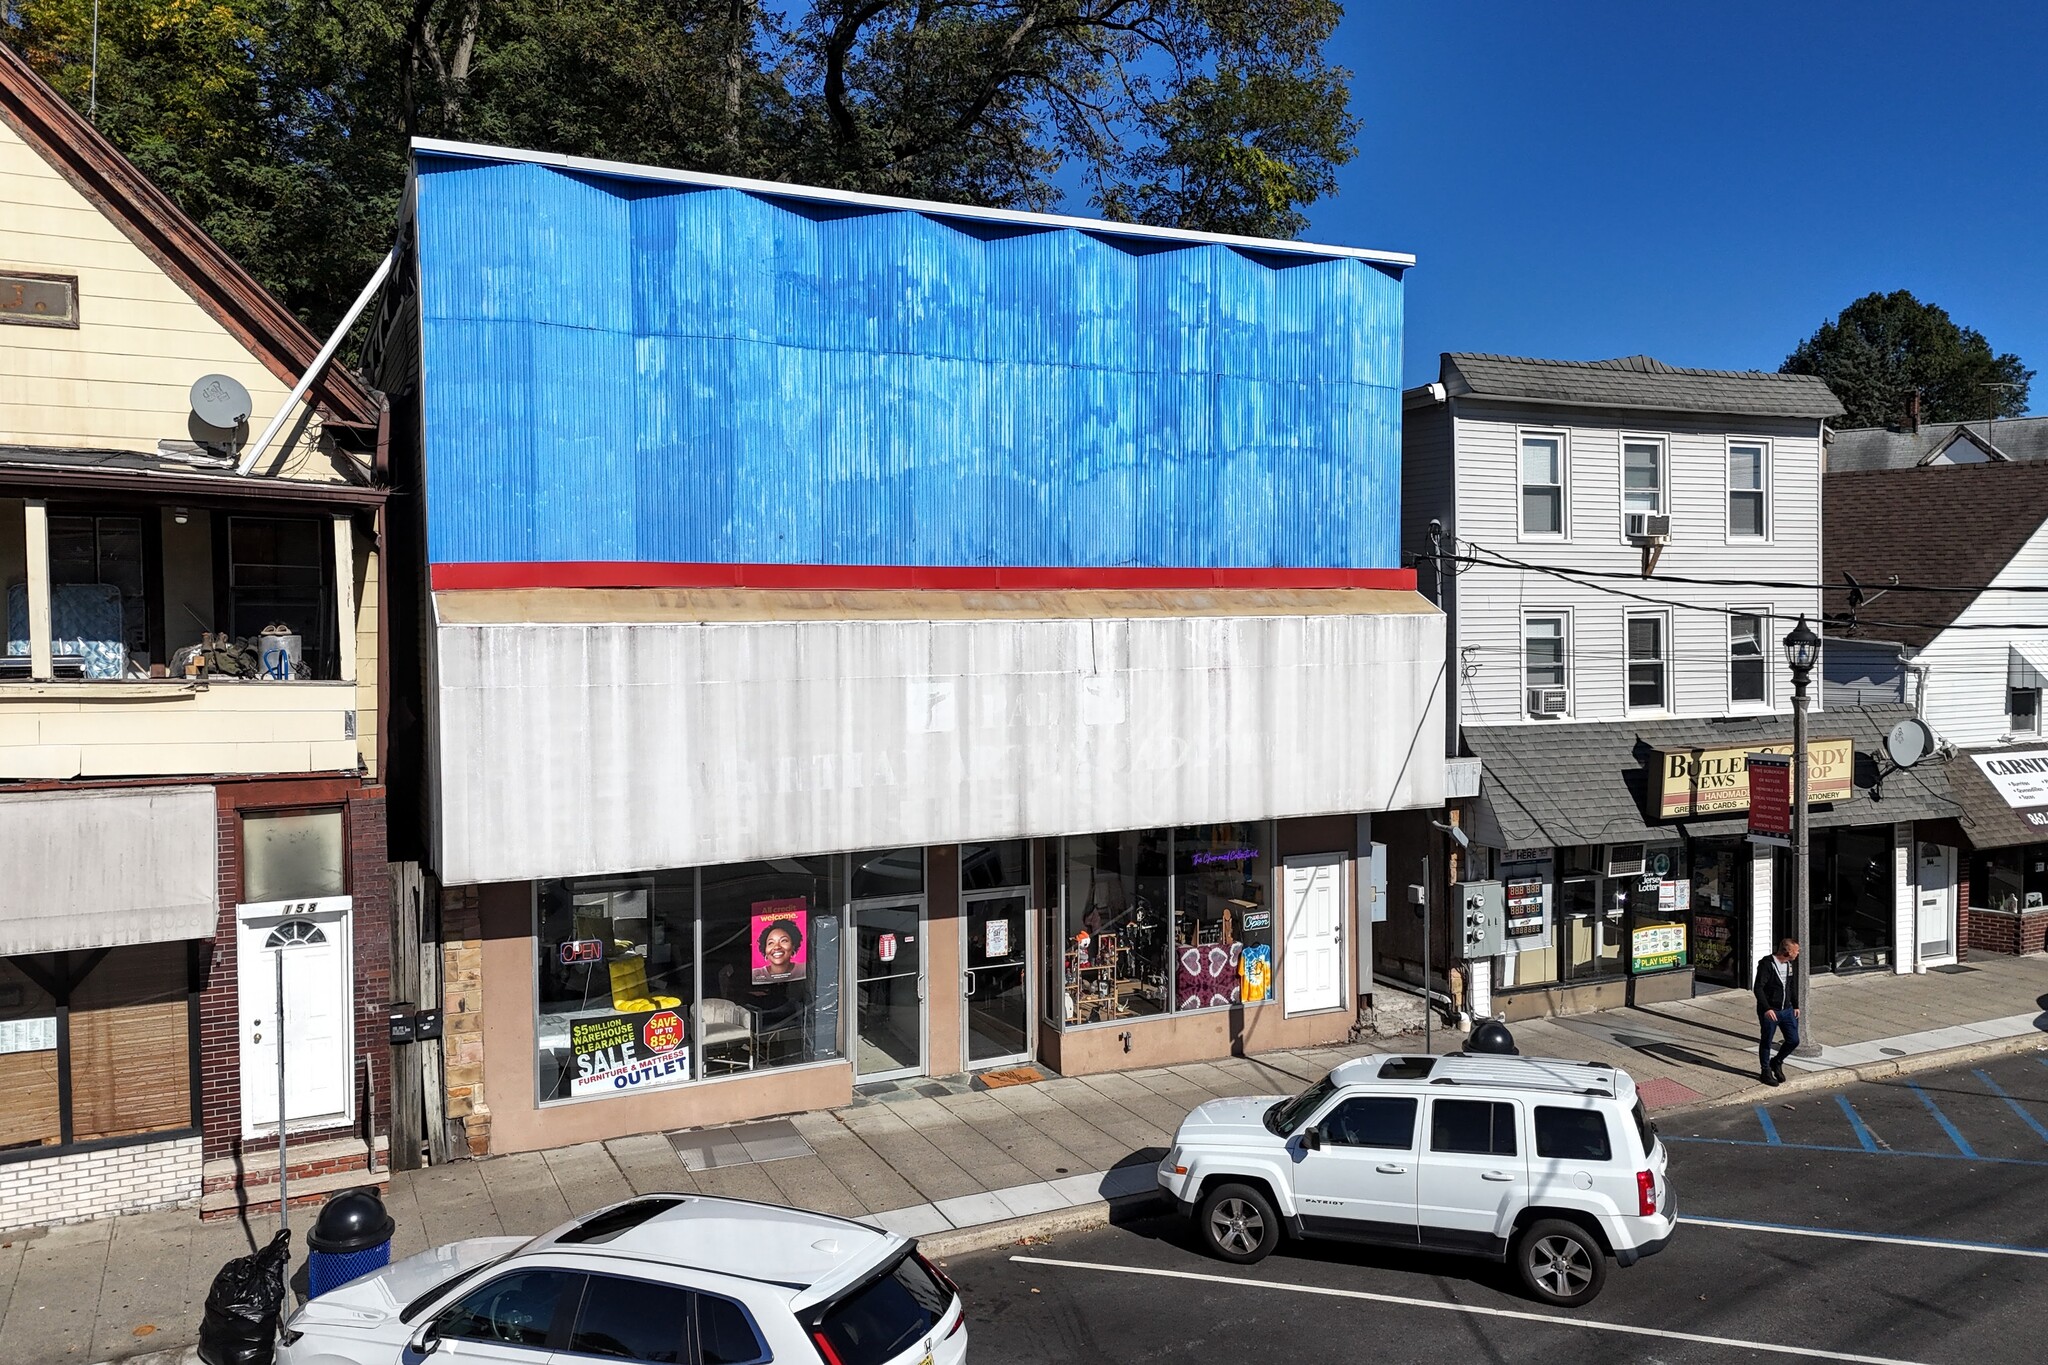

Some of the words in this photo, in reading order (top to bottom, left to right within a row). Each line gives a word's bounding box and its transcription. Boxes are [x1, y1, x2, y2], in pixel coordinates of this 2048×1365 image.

[1687, 773, 1735, 790] NEWS
[1674, 804, 1710, 813] GREETING
[1712, 801, 1737, 810] CARDS
[1806, 791, 1840, 801] ATIONERY
[1517, 851, 1537, 859] HERE
[1639, 884, 1660, 892] Lotter
[282, 902, 318, 915] 158
[563, 942, 600, 961] OPEN
[1641, 957, 1658, 967] PLAY
[650, 1016, 678, 1029] SAVE
[573, 1023, 634, 1046] WAREHOUSE
[575, 1032, 635, 1055] CLEARANCE
[650, 1033, 679, 1048] 85%
[577, 1041, 638, 1078] SALE
[578, 1066, 629, 1086] FURNITURE
[639, 1049, 684, 1069] MATTRESS
[614, 1057, 687, 1089] OUTLET
